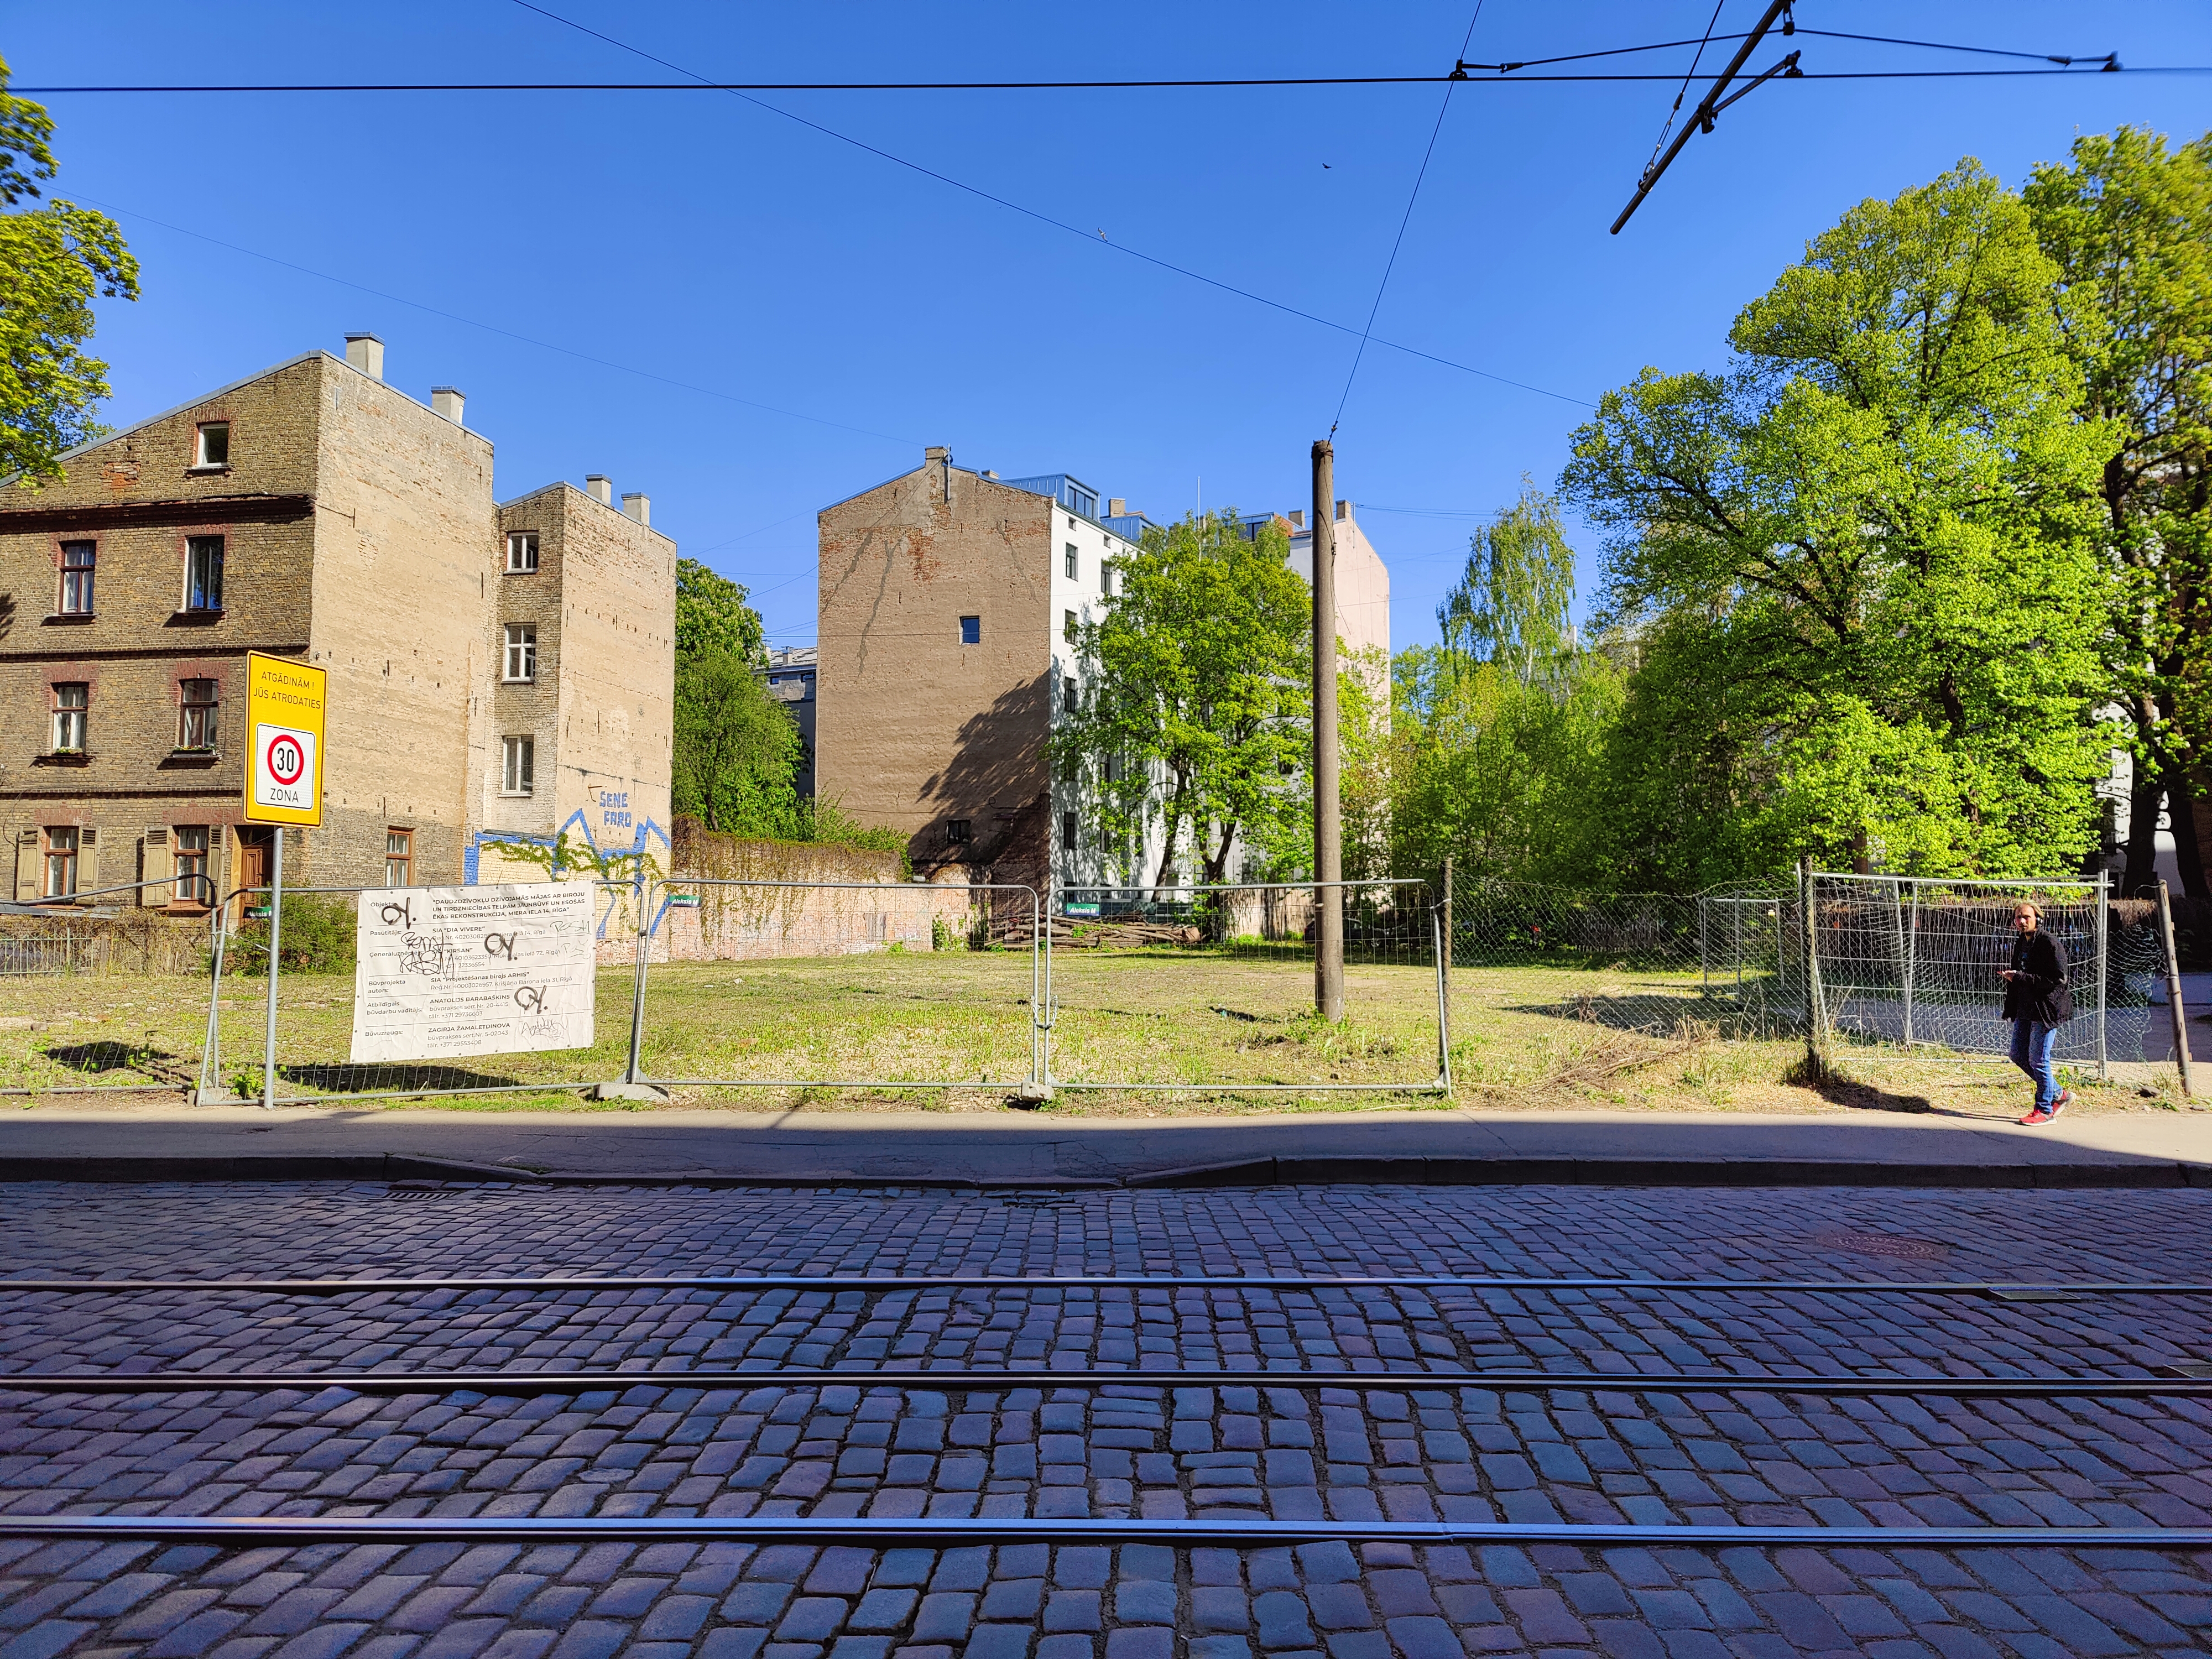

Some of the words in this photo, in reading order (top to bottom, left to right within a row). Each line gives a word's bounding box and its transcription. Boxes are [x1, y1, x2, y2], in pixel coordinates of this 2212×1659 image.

[262, 671, 310, 689] ATGĀDINĀM
[253, 687, 269, 698] JŪS
[271, 692, 321, 709] ATRODATIES
[277, 748, 294, 772] 30
[270, 788, 299, 802] ZONA
[456, 1022, 510, 1031] ŽAMALETDINOVA
